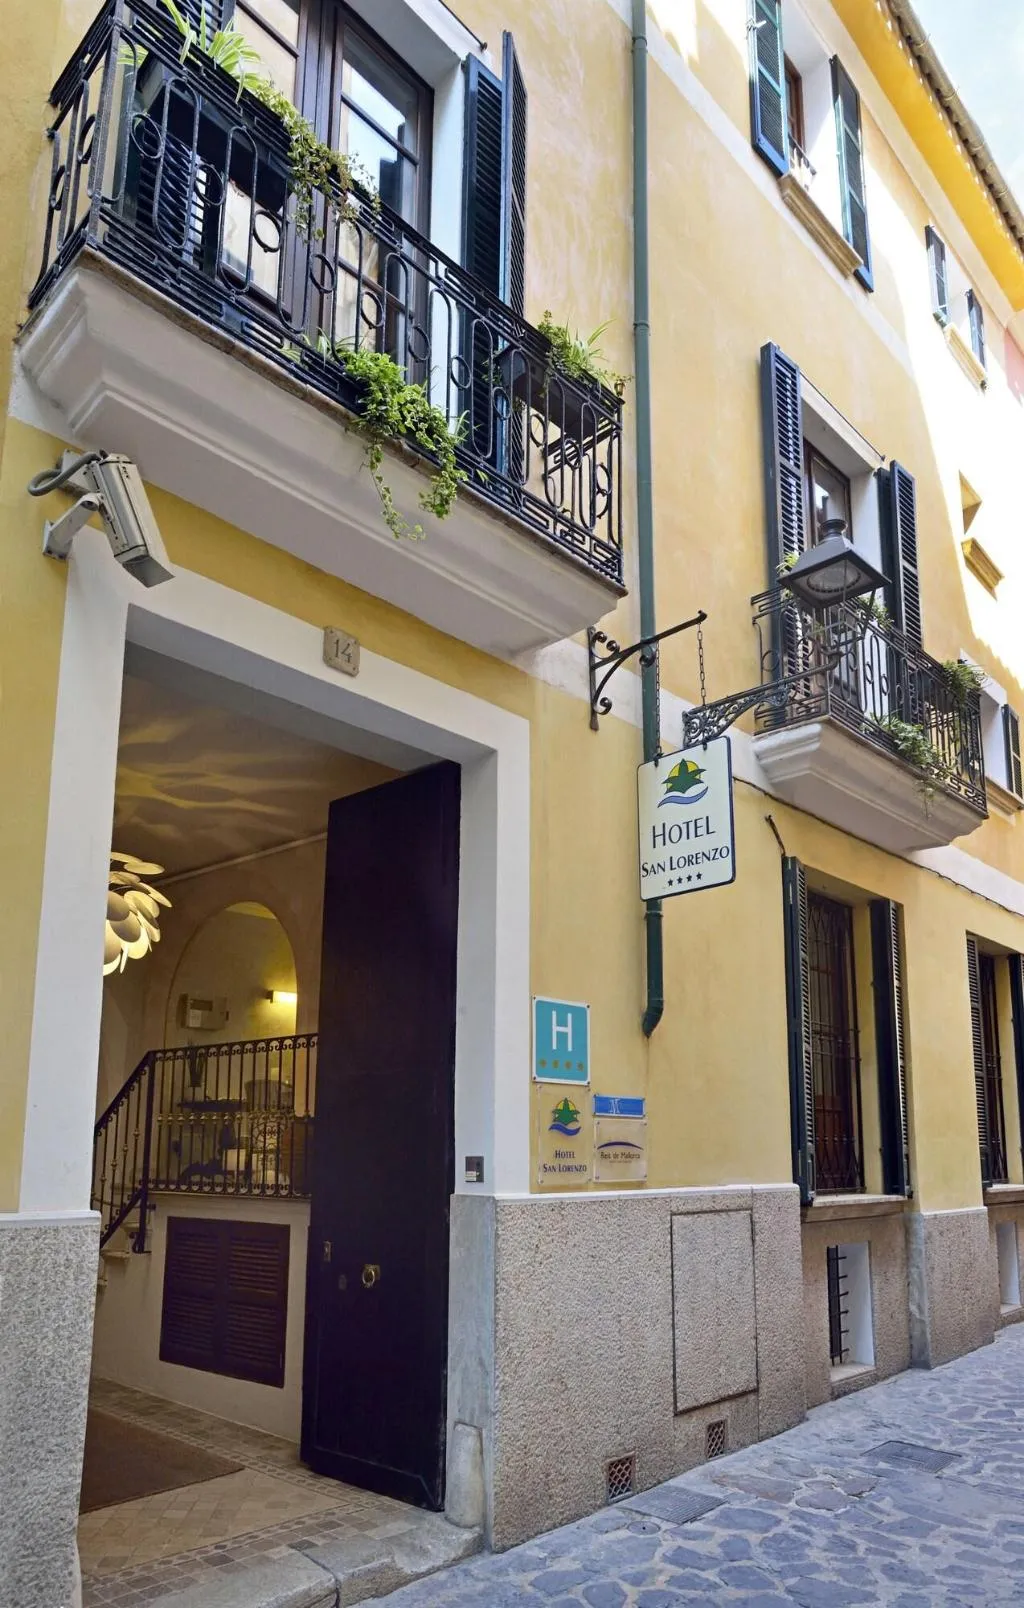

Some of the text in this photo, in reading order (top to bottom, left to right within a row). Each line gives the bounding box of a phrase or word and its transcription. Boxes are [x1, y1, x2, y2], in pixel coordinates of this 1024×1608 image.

[335, 639, 353, 664] 14
[652, 815, 716, 849] HOTEL
[641, 845, 730, 877] SAN LORENZO
[551, 1010, 573, 1052] H
[543, 1163, 588, 1173] SAN LORENZO
[554, 1149, 576, 1159] HOTEL
